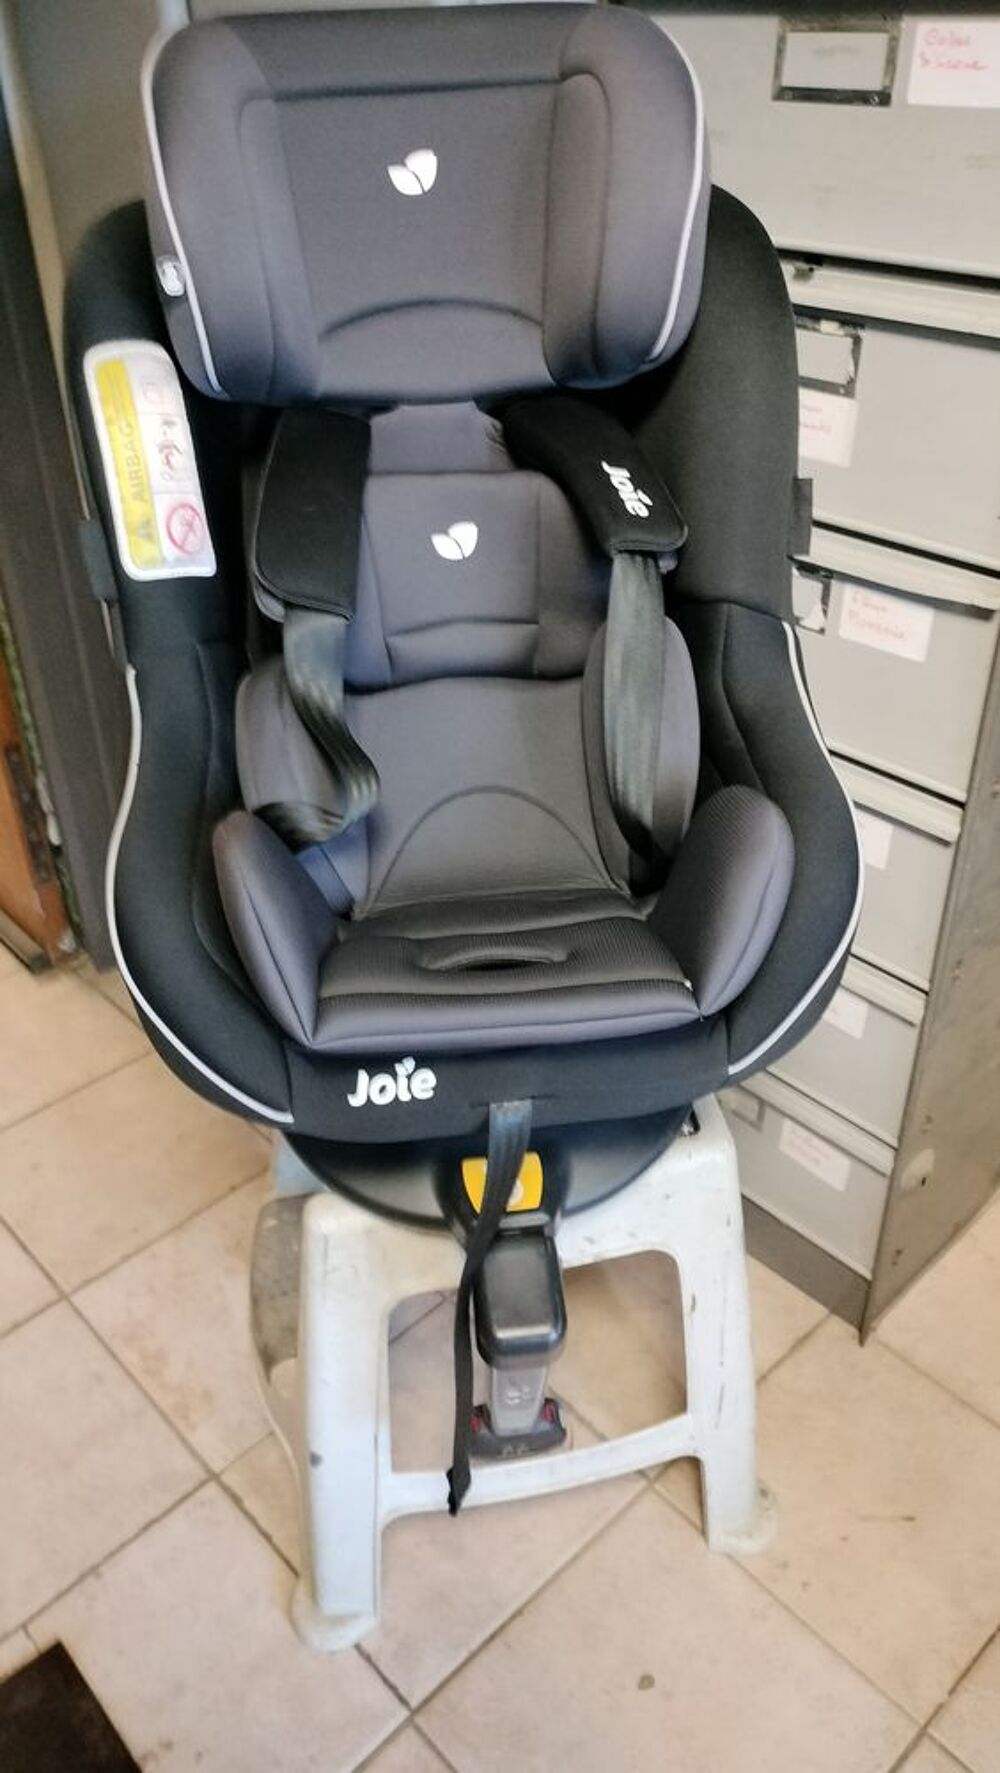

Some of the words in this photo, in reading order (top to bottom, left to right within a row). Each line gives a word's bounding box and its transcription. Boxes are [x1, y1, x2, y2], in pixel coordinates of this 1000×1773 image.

[118, 419, 147, 503] AIRBAG
[601, 460, 653, 518] Joie
[347, 1056, 437, 1108] Joie
